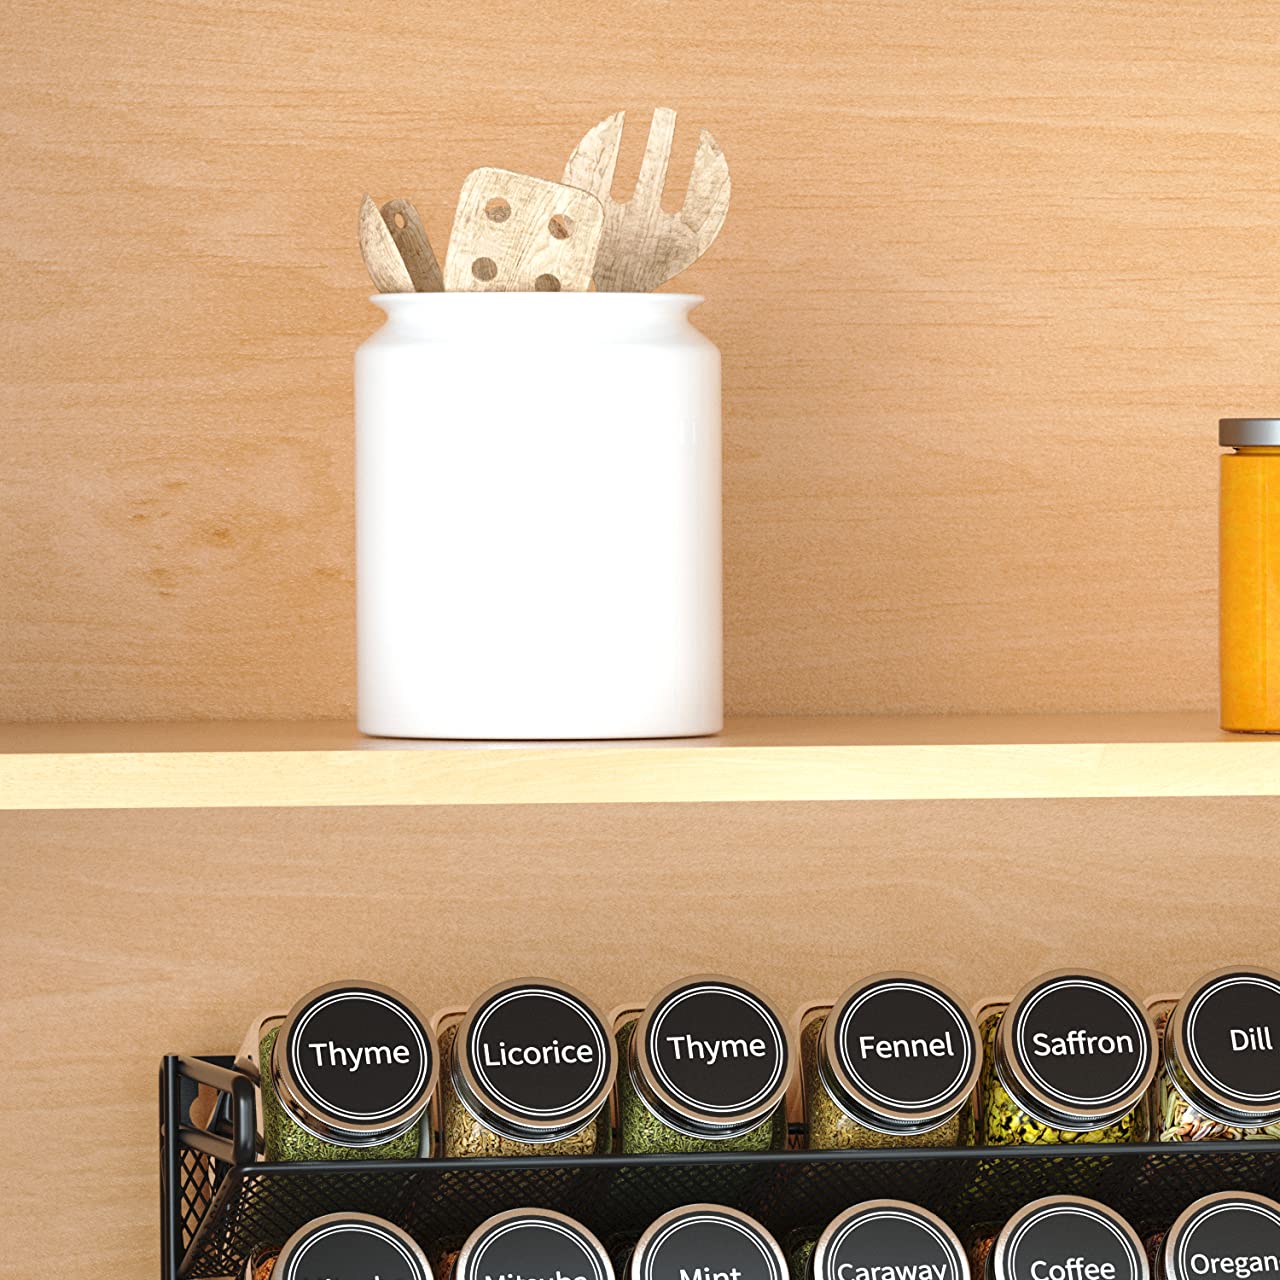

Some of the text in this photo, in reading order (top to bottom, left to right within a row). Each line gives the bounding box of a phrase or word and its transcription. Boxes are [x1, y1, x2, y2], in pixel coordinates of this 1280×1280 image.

[483, 1039, 593, 1066] Licorice
[666, 1034, 766, 1065] Thyme
[859, 1031, 955, 1059] Fennel
[1032, 1029, 1134, 1057] Saffron
[1230, 1026, 1273, 1051] Dill
[308, 1040, 410, 1072] Thyme
